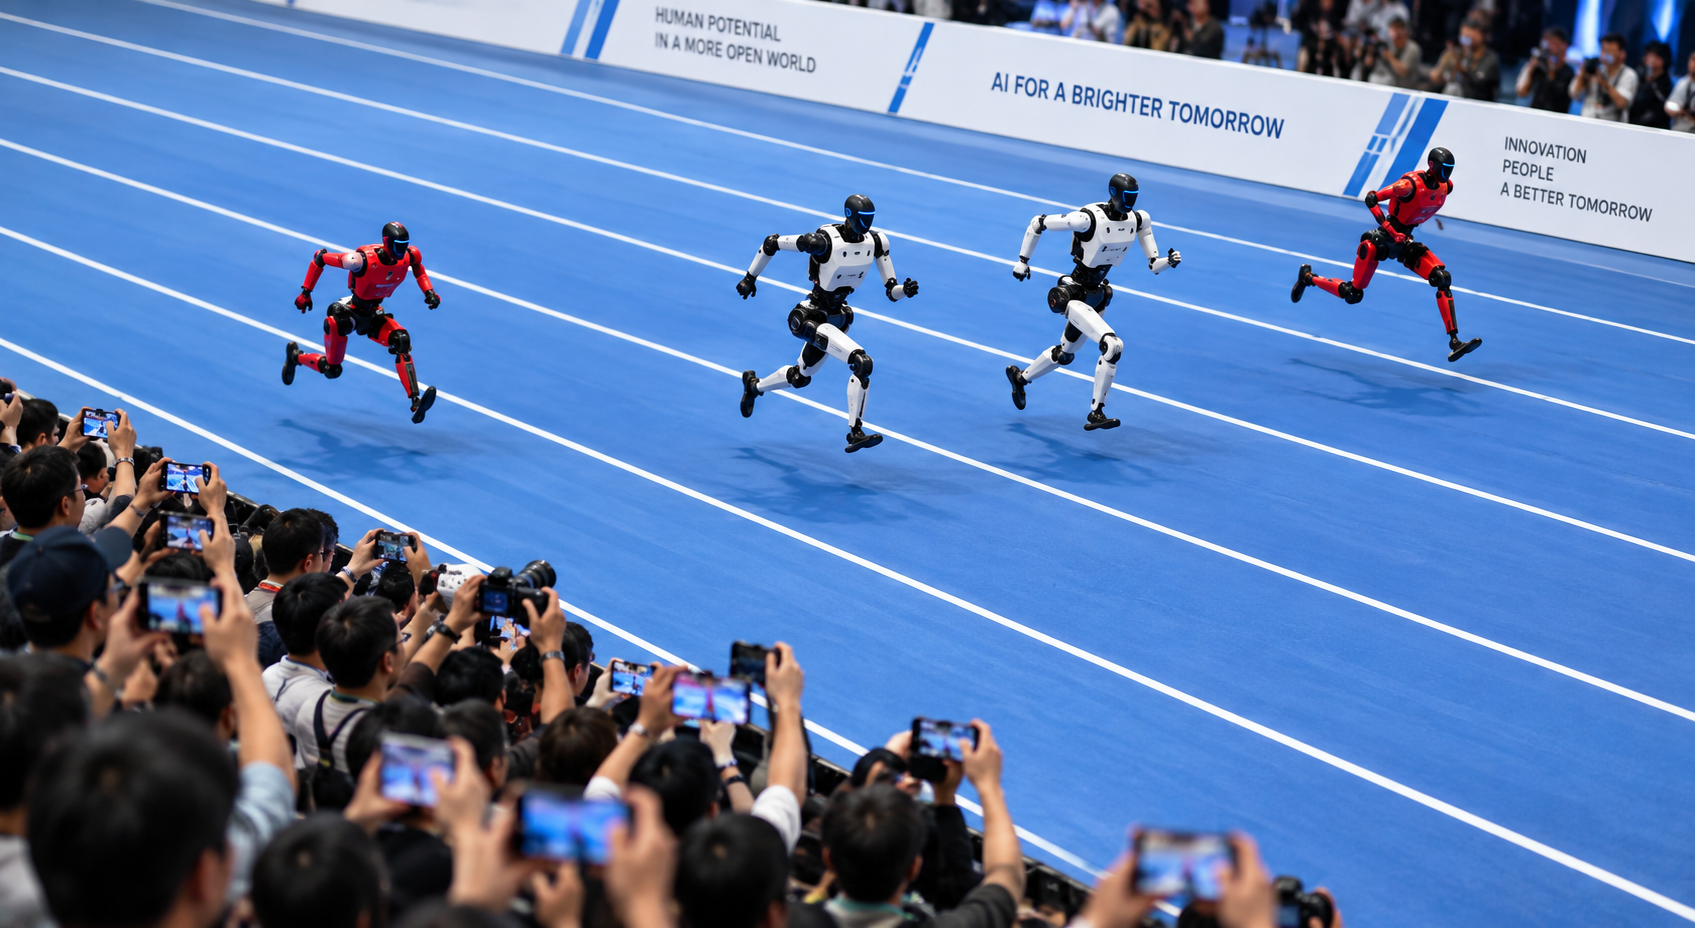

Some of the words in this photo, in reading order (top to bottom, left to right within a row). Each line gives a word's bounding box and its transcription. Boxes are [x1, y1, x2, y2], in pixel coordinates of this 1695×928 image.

[655, 6, 704, 29] HUMAN
[708, 15, 781, 42] POTENTIAL
[655, 32, 668, 49] IN
[672, 35, 681, 51] A
[684, 36, 723, 58] MORE
[726, 43, 763, 65] OPEN
[766, 50, 816, 73] WORLD
[991, 72, 1009, 92] AI
[1014, 75, 1049, 100] FOR
[1053, 82, 1066, 102] A
[1071, 84, 1163, 119] BRIGHTER
[1168, 100, 1285, 139] TOMORROW
[1504, 136, 1587, 164] INNOVATION
[1502, 159, 1554, 181] PEOPLE
[1500, 182, 1510, 197] A
[1513, 184, 1564, 206] BETTER
[1568, 193, 1653, 222] TOMORROW
